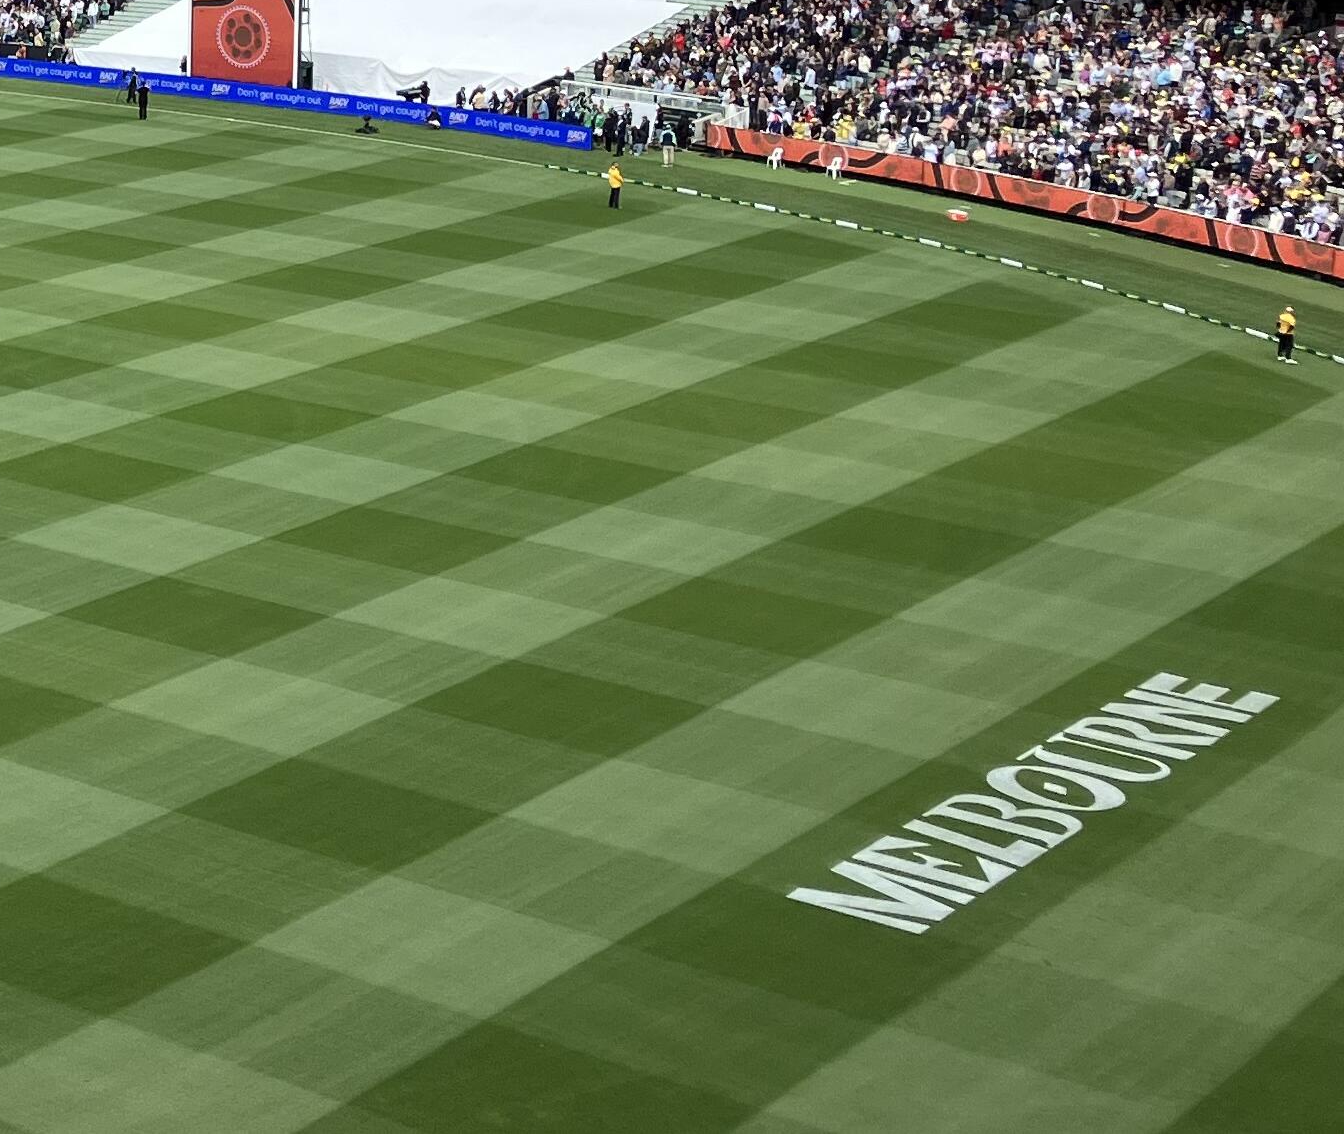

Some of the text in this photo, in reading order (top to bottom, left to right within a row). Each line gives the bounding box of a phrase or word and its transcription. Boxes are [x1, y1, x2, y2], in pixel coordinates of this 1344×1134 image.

[14, 63, 92, 79] Don't get caught out
[100, 70, 118, 80] RACV
[161, 79, 190, 92] caught
[190, 82, 205, 92] out
[211, 83, 231, 94] RACV
[237, 87, 322, 106] Don't get caught out
[329, 96, 349, 107] RACV
[356, 101, 378, 111] Don't
[379, 106, 395, 115] get
[395, 107, 426, 120] caught
[449, 111, 469, 122] RACV
[475, 116, 560, 138] Don't get caught out
[567, 129, 588, 140] RACV
[785, 671, 1280, 935] MELBOURNE
